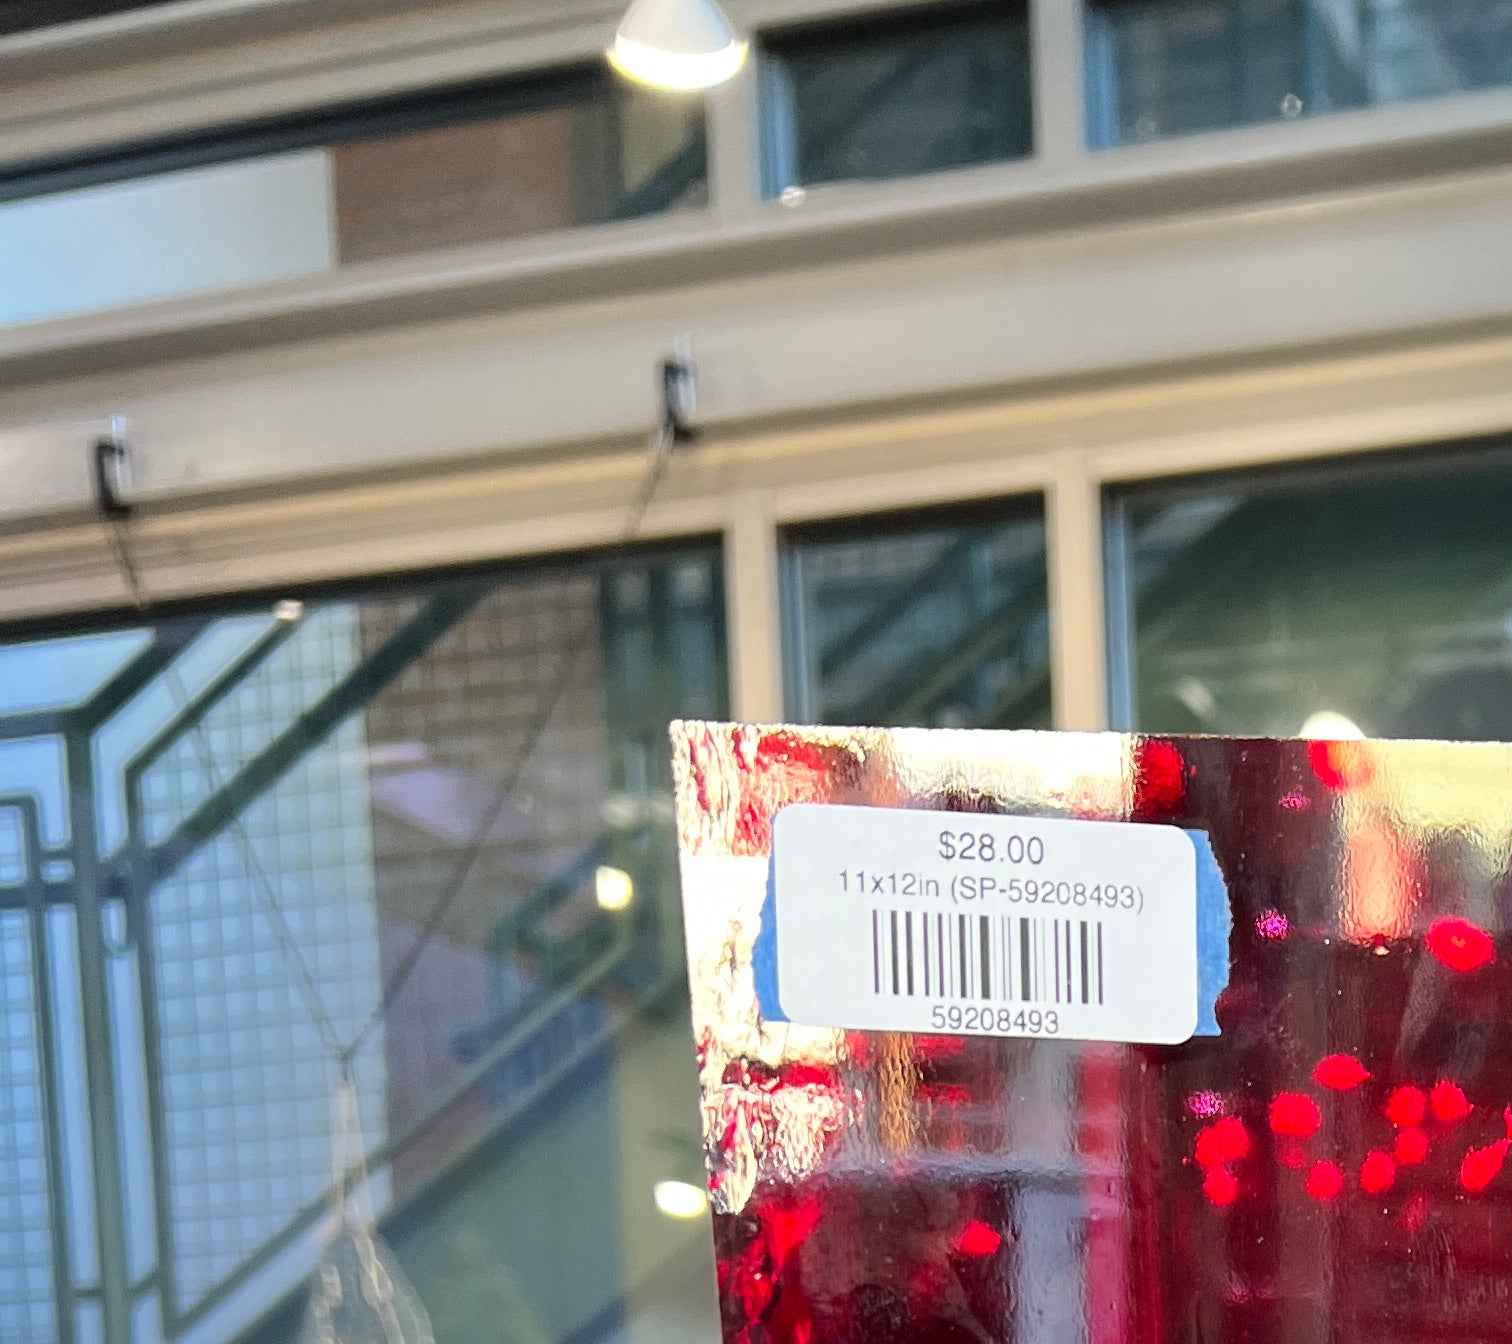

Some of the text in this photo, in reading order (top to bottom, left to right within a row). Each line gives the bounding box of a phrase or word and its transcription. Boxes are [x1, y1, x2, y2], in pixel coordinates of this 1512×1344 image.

[938, 831, 1045, 865] $28.00
[838, 870, 1145, 914] 11x12in (SP-59208493)
[931, 1005, 1060, 1034] 59208493
